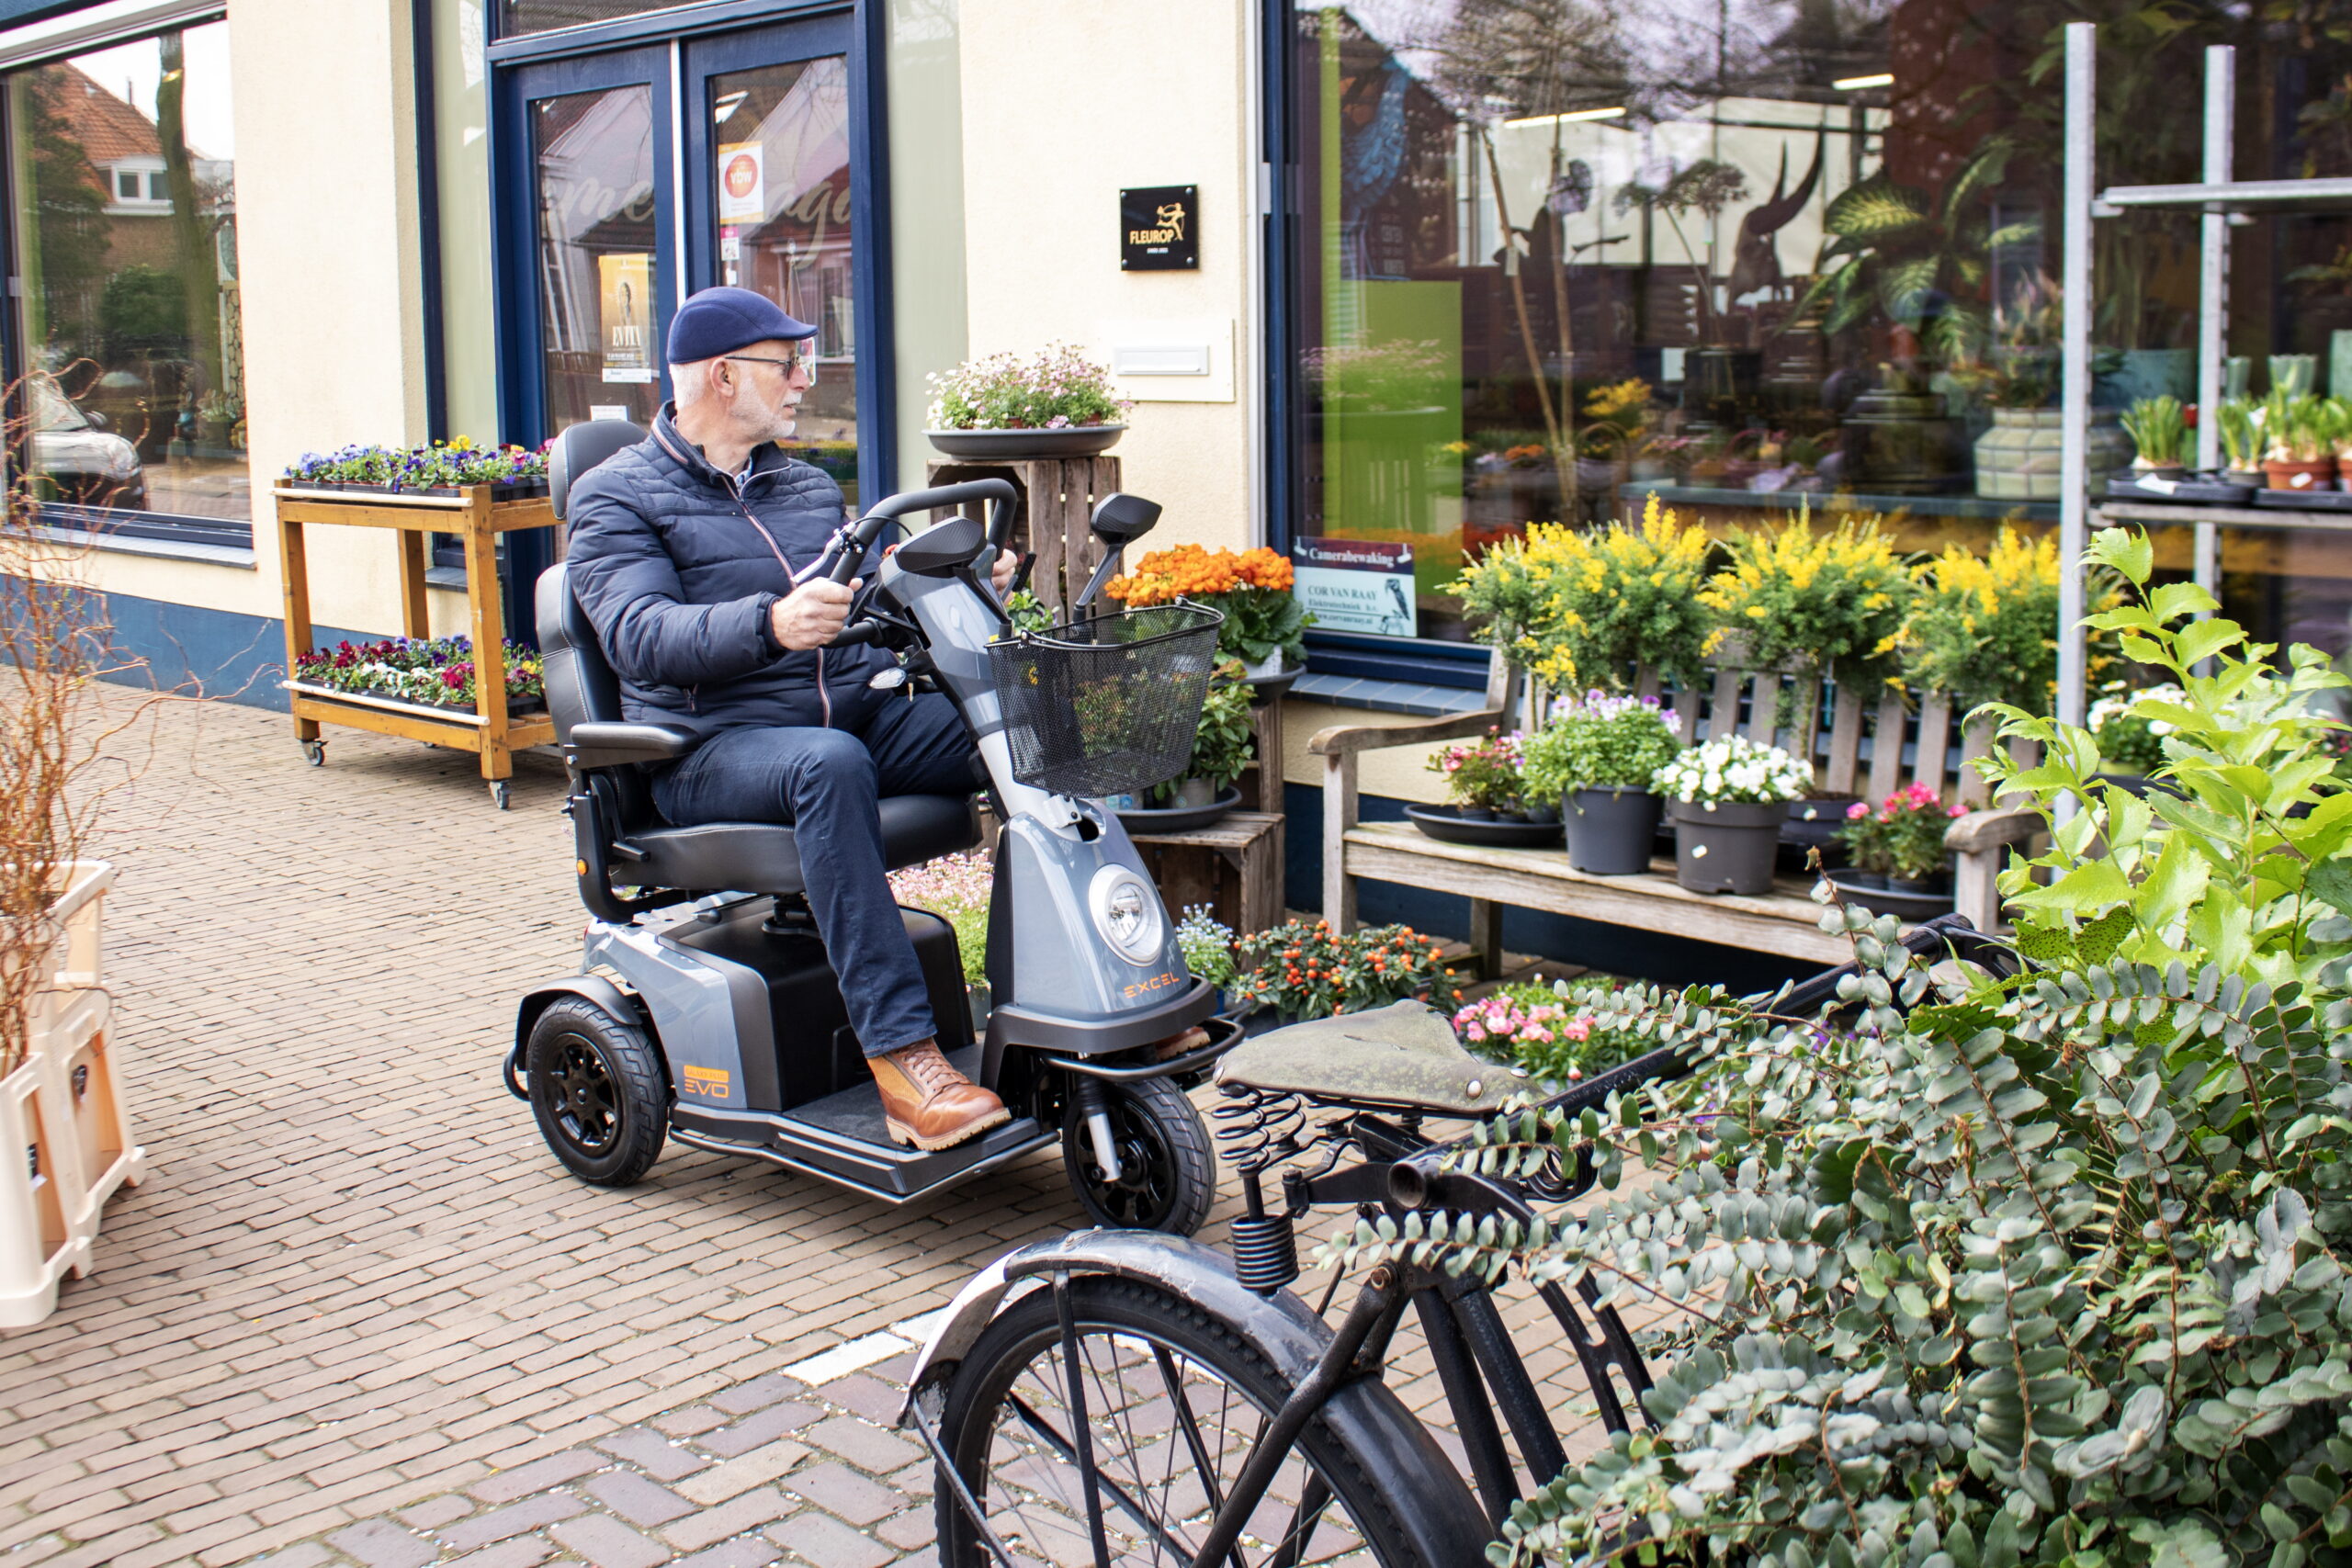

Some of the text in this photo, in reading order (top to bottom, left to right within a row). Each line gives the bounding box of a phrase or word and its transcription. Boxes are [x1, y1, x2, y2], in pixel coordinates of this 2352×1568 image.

[730, 169, 752, 184] vbw
[1129, 229, 1175, 244] FLEUROP
[1308, 547, 1395, 569] Camerabewaking
[1307, 585, 1377, 600] COR VAN RAAY
[1123, 972, 1180, 998] EXCEL
[684, 1078, 729, 1099] EVO
